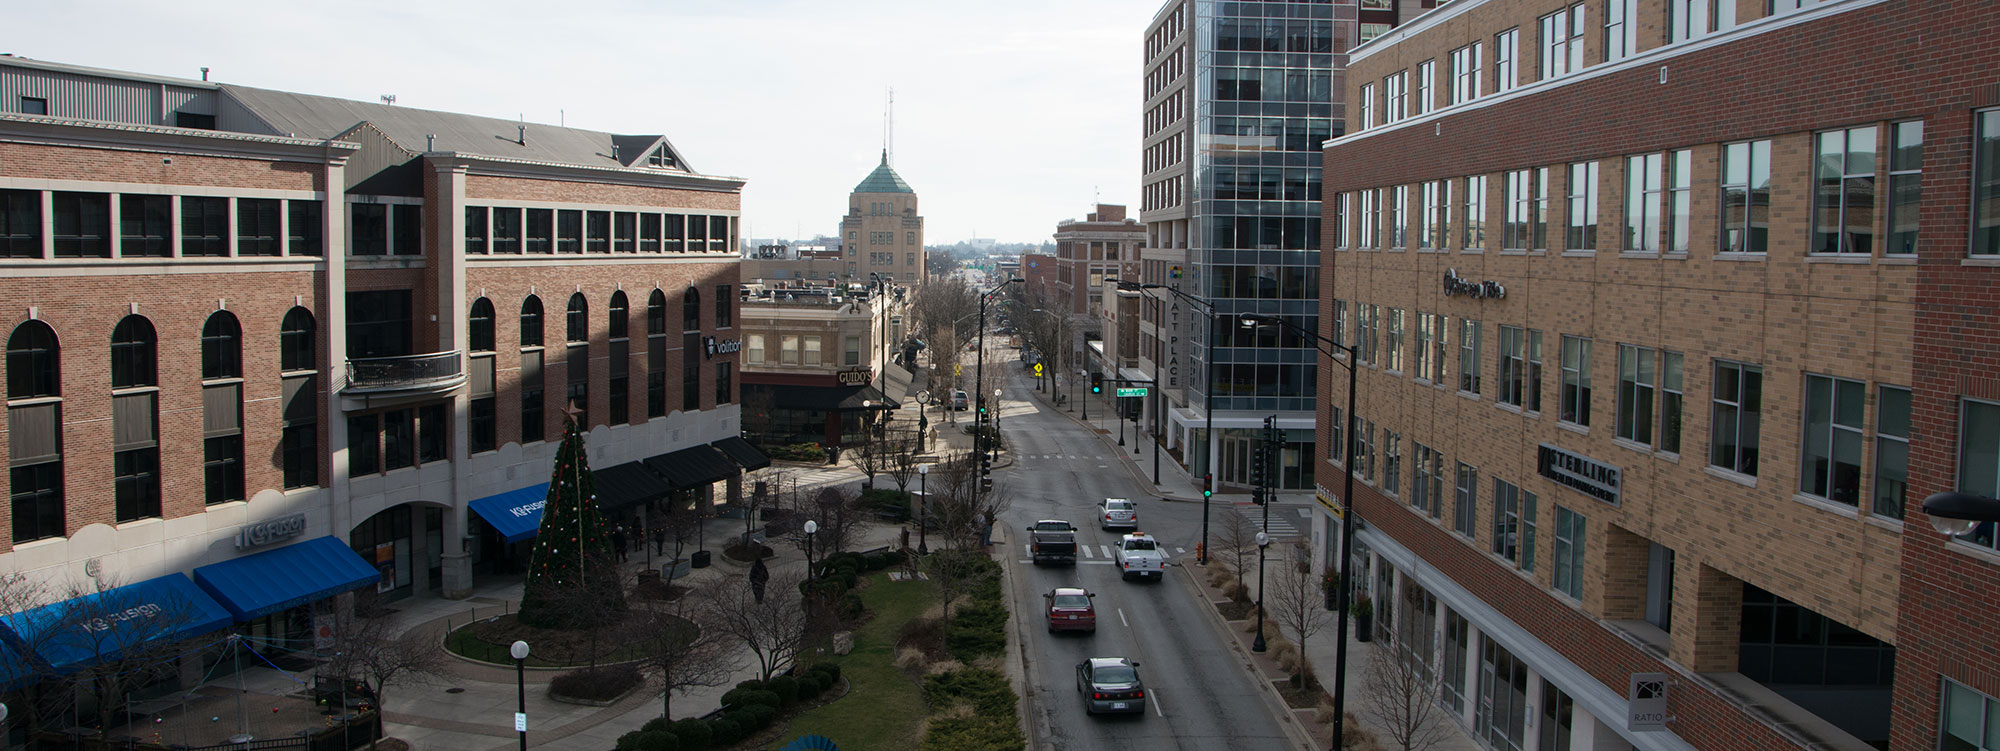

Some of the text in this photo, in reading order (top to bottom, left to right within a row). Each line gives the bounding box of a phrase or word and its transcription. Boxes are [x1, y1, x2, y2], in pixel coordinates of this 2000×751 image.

[1169, 283, 1180, 386] HYATT PLACE
[716, 339, 742, 354] volition
[839, 371, 872, 383] GUIDO'S
[1550, 449, 1616, 487] STERLING
[1634, 713, 1663, 722] RATIO
